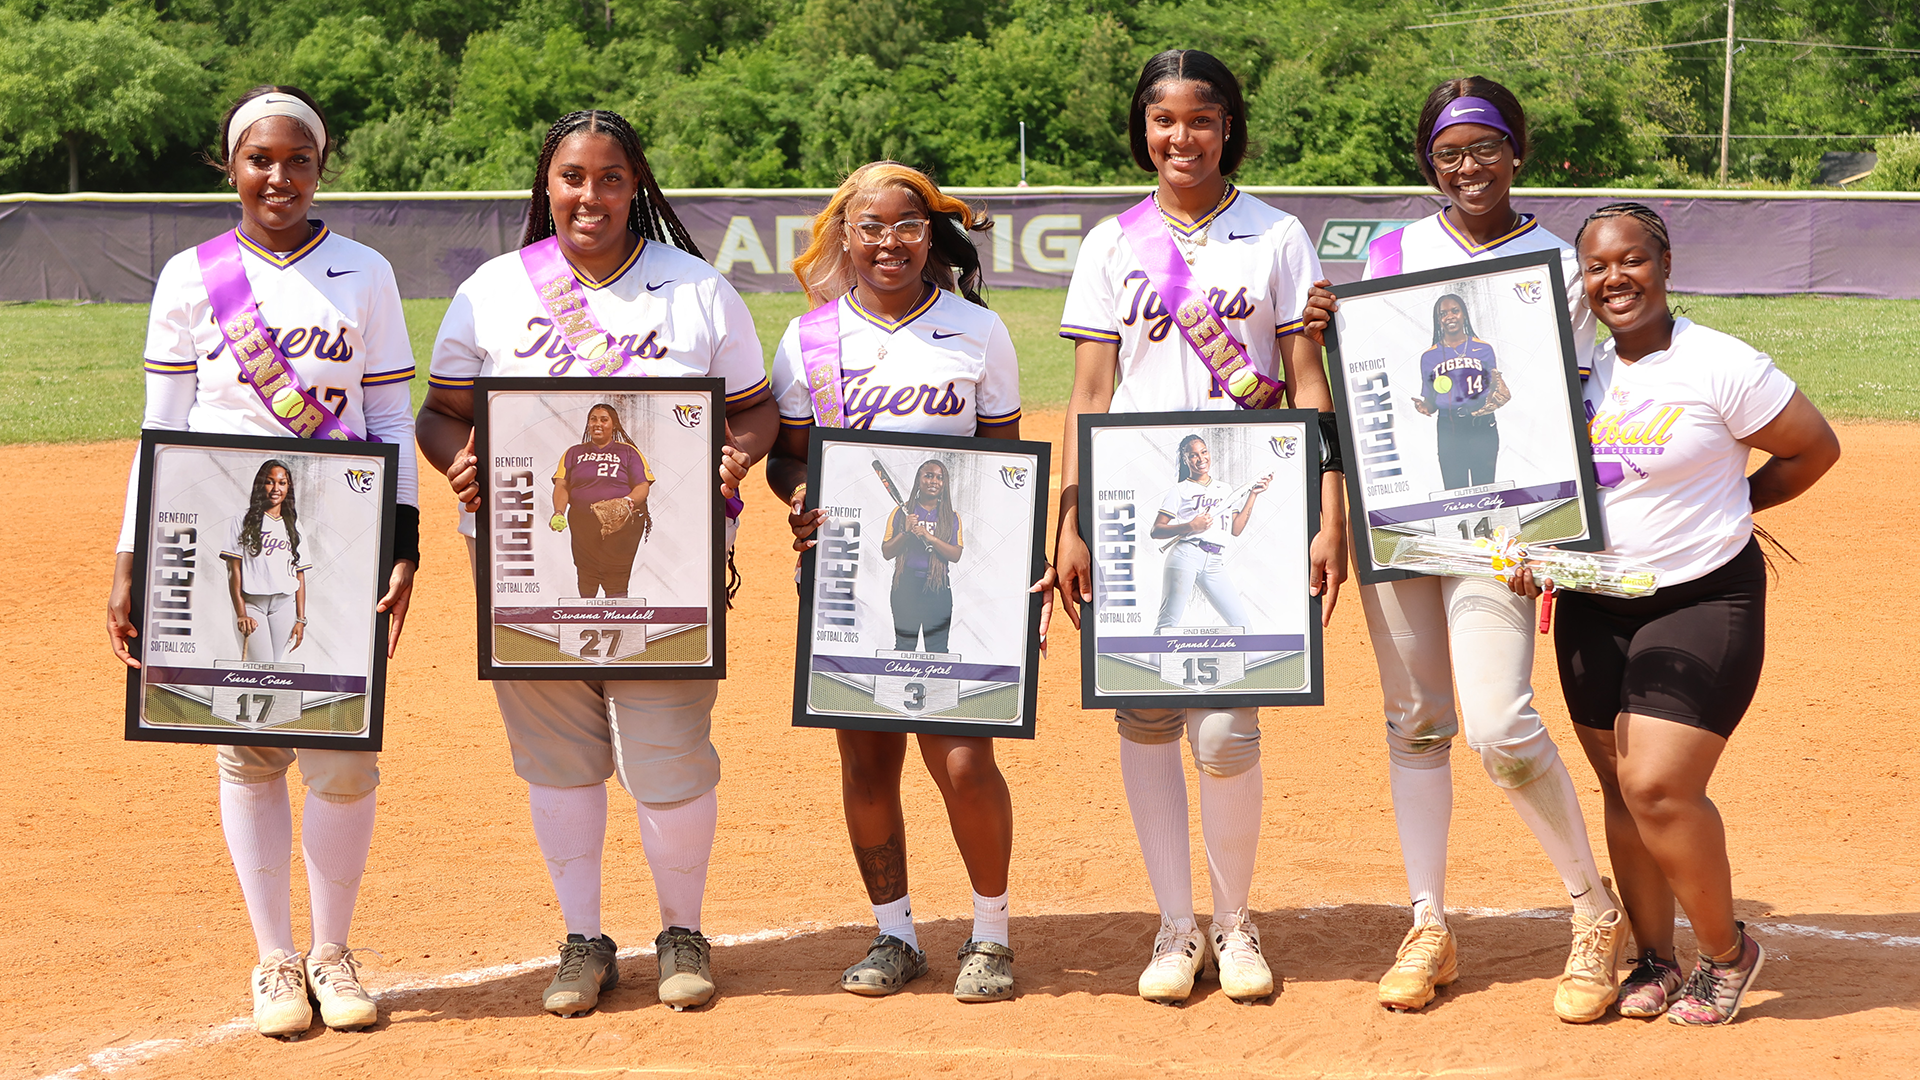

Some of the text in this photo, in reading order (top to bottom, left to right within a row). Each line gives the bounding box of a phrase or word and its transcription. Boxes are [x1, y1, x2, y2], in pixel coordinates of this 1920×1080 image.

[1349, 357, 1386, 374] BENEDICT
[1433, 357, 1483, 378] TIGERS
[1466, 375, 1483, 395] 14
[1351, 371, 1403, 484] TIGERS
[1589, 406, 1685, 445] tball
[495, 456, 534, 468] BENEDICT
[577, 452, 621, 464] TIGERS
[597, 462, 620, 478] 27
[1099, 489, 1135, 501] BENEDICT
[1367, 480, 1410, 497] SOFTBALL 2025
[1454, 486, 1489, 497] OUTFIELD
[1477, 494, 1505, 513] Cady
[158, 511, 198, 525] BENEDICT
[824, 506, 862, 519] BENEDICT
[495, 470, 535, 581] TIGERS
[1457, 516, 1494, 541] 14
[260, 530, 293, 556] Tiger
[1098, 503, 1137, 611] TIGERS
[152, 526, 198, 640] TIGERS
[816, 520, 862, 630] TIGERS
[496, 582, 540, 594] SOFTBALL 2025
[552, 609, 655, 621] Savanna Marshall
[1099, 612, 1141, 623] SOFTBALL 2025
[579, 629, 624, 657] 27
[816, 630, 859, 643] SOFTBALL 2025
[1210, 638, 1237, 649] Lake
[150, 640, 196, 654] SOFTBALL 2025
[900, 653, 935, 661] OUTFIELD
[242, 662, 274, 671] PITCHER
[1182, 657, 1220, 686] 15
[222, 671, 294, 686] Kierra Evans
[903, 682, 927, 711] 3
[235, 693, 275, 724] 17
